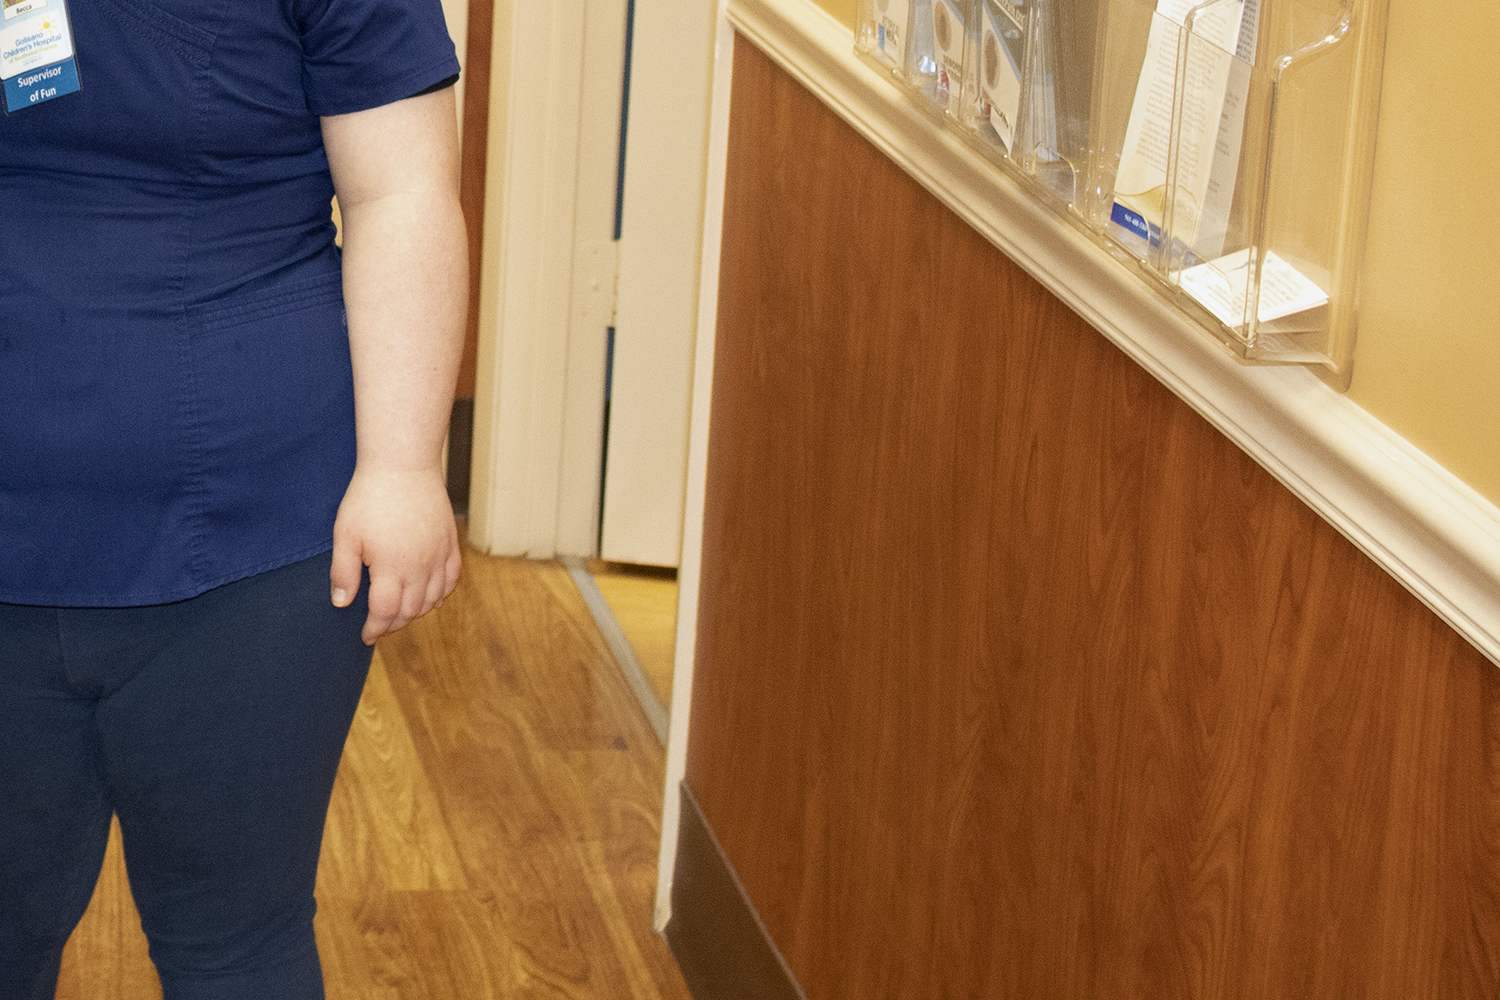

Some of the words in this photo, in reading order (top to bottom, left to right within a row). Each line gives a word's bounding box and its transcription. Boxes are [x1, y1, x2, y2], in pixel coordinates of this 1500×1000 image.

[16, 4, 32, 14] Becca
[3, 42, 33, 60] Children's
[33, 33, 62, 49] Hospital
[15, 33, 43, 47] Golisano
[18, 66, 62, 88] Supervisor
[30, 90, 39, 102] of
[40, 86, 57, 99] Fun
